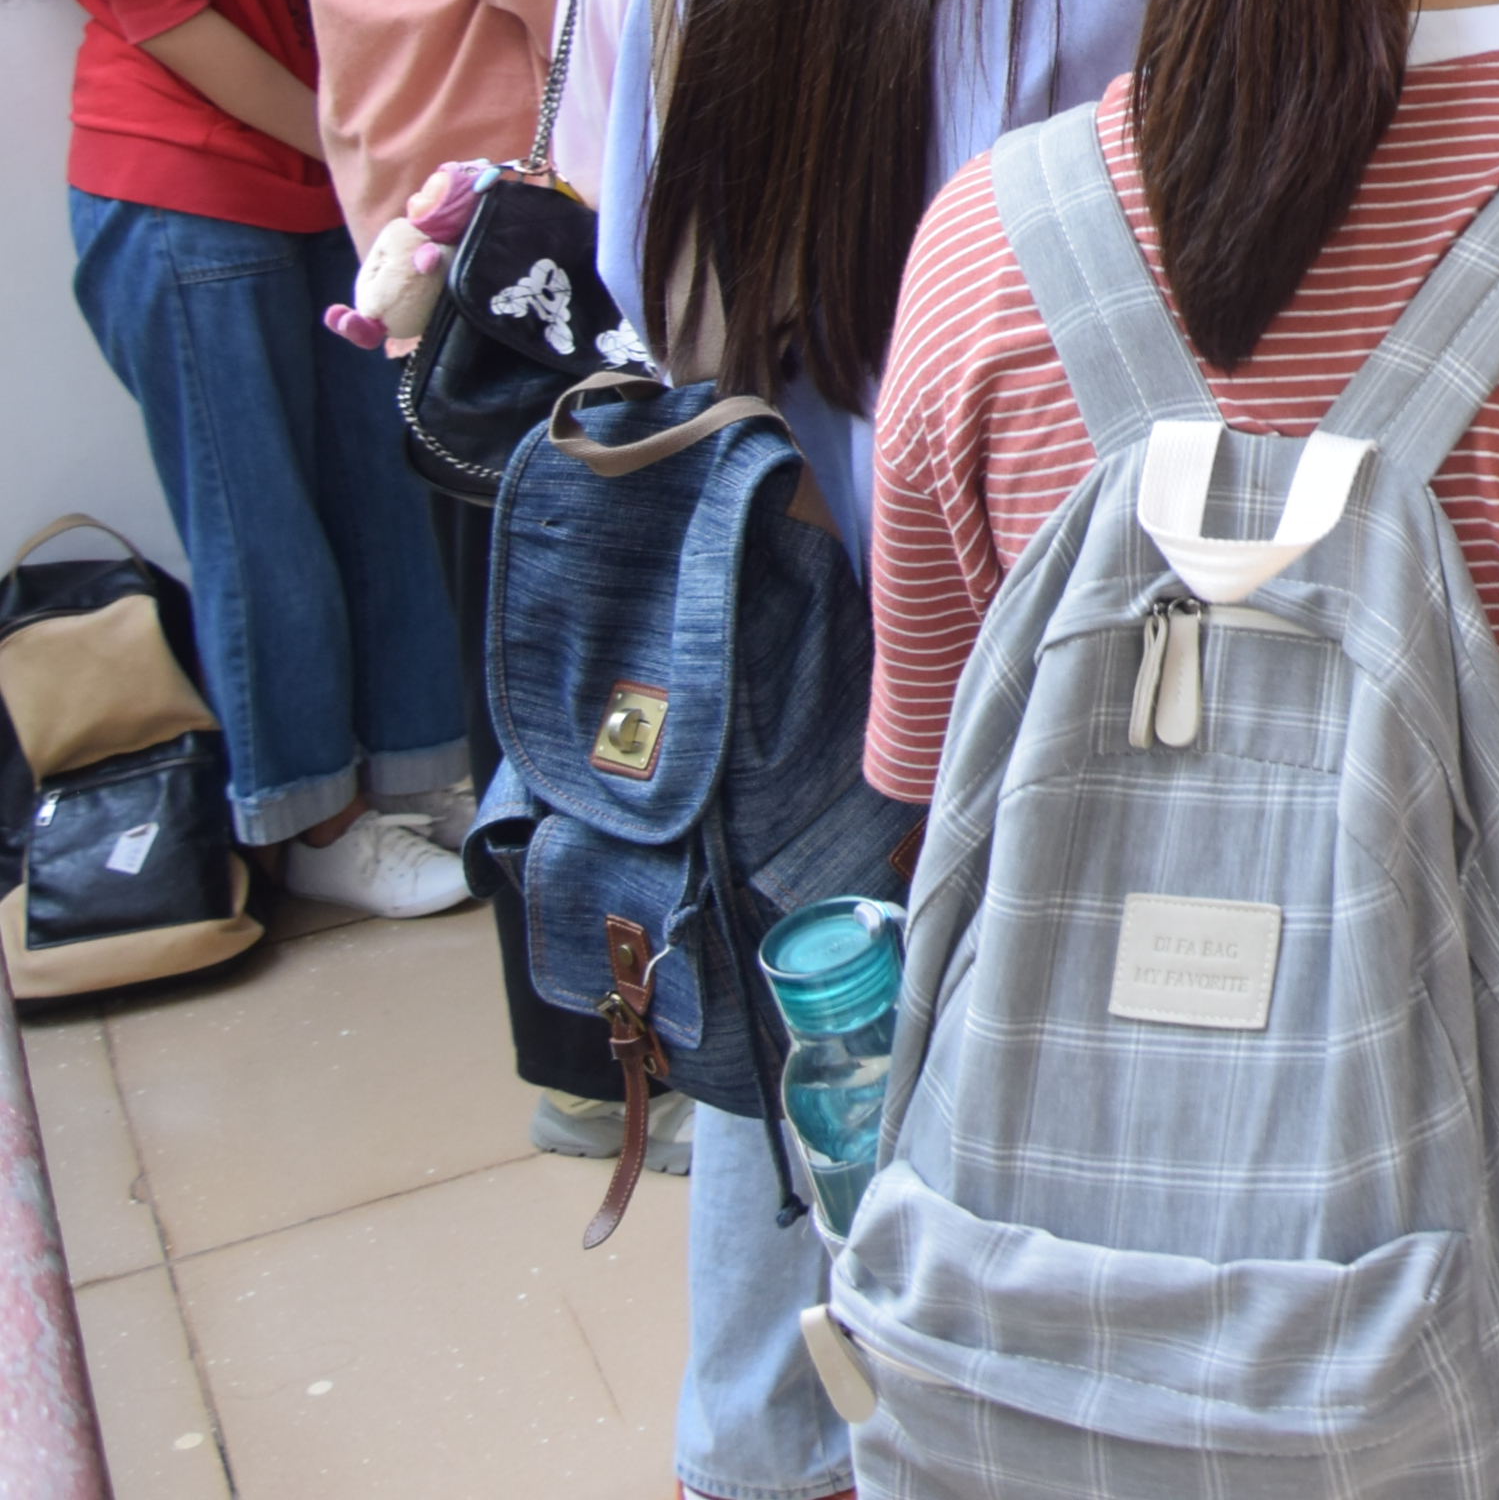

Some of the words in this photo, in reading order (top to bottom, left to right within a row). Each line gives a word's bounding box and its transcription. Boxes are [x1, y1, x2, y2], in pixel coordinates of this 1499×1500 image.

[1175, 938, 1197, 956] FA
[1201, 940, 1238, 959] BAG
[1134, 966, 1161, 985] MY
[1165, 970, 1249, 993] FAVORITE
